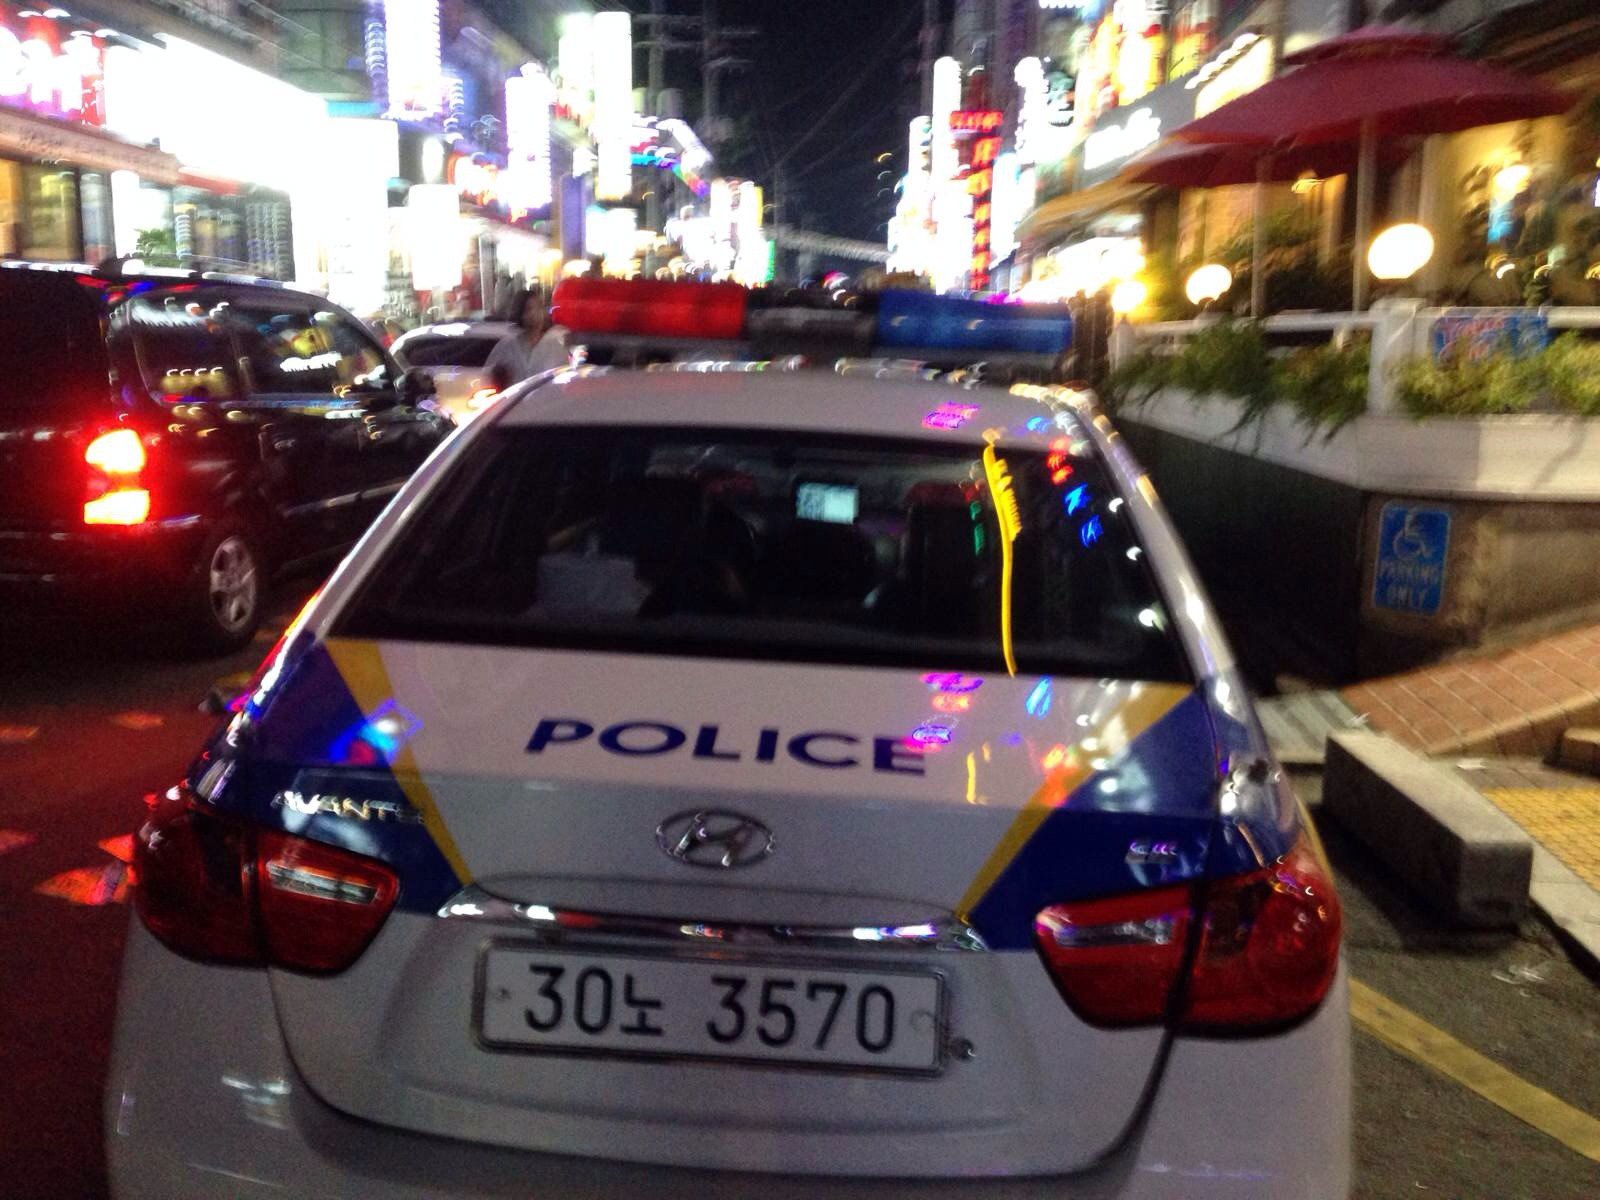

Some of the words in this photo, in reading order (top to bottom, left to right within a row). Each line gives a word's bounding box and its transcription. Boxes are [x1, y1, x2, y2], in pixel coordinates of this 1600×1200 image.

[525, 718, 927, 776] POLICE
[270, 789, 425, 826] AVANT
[524, 964, 664, 1037] 30노
[707, 976, 896, 1055] 3570
